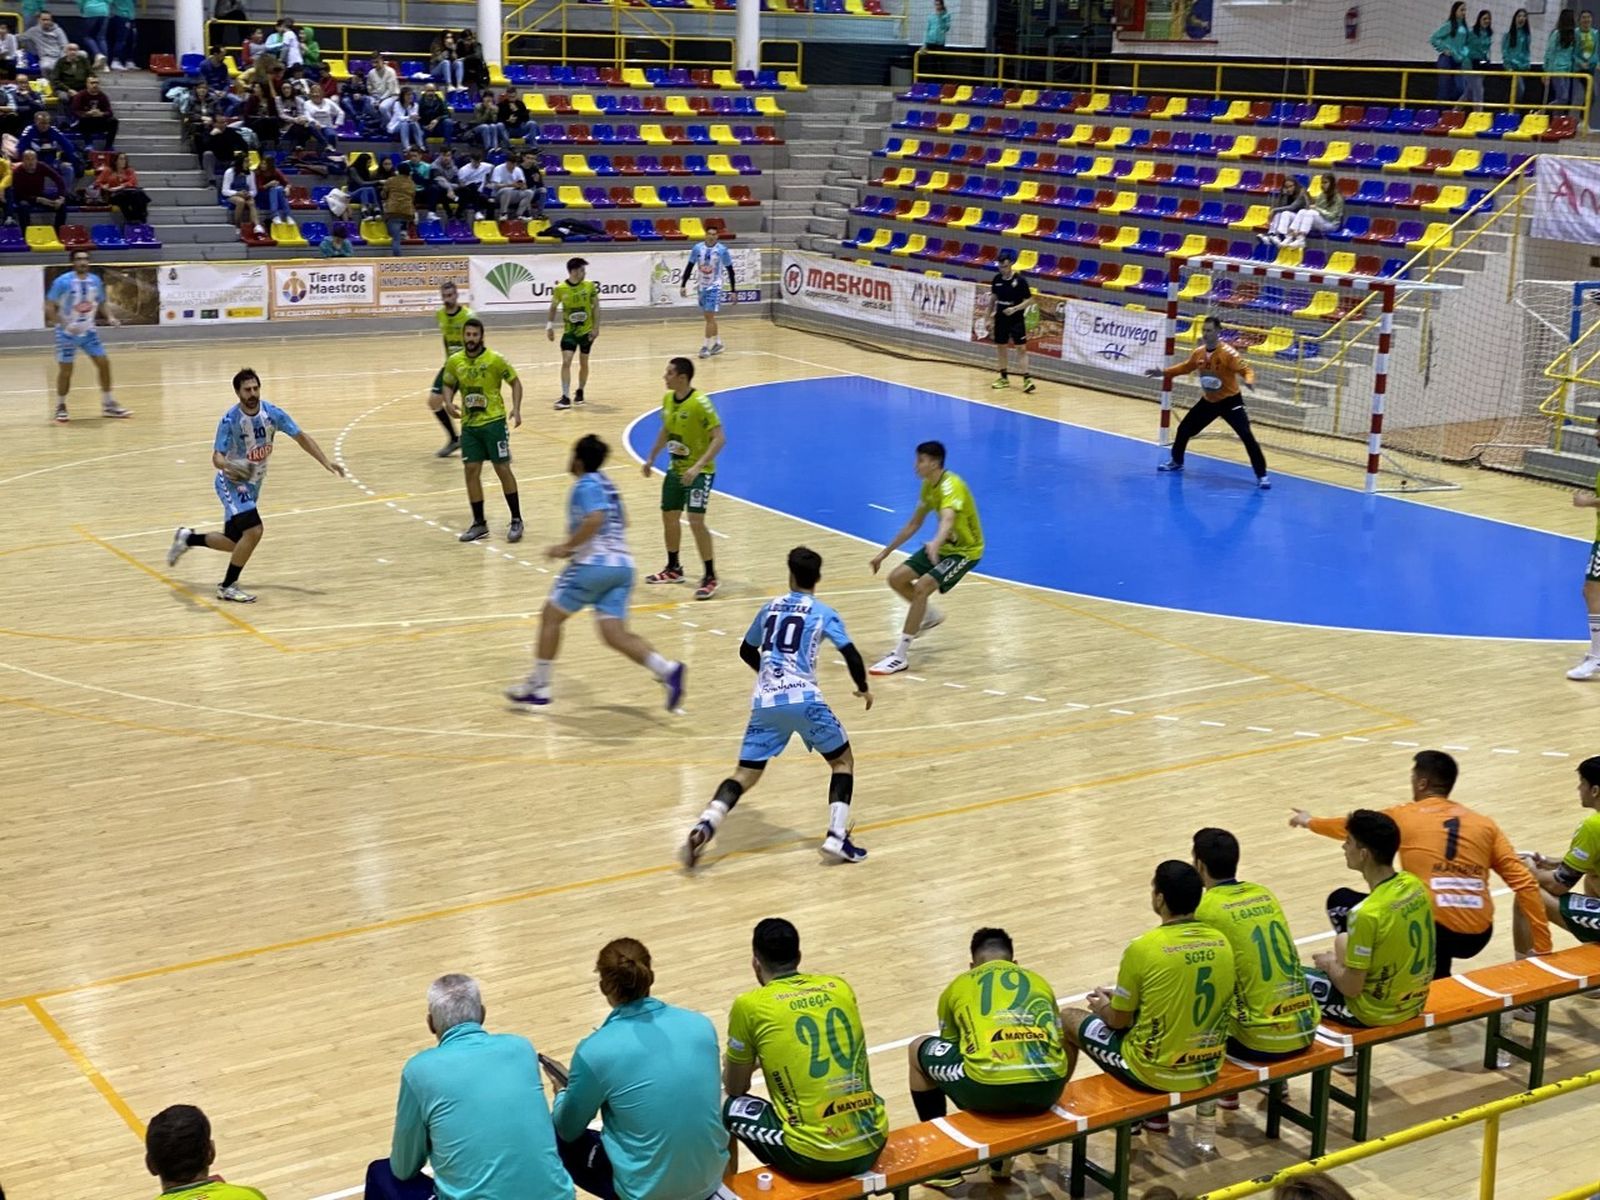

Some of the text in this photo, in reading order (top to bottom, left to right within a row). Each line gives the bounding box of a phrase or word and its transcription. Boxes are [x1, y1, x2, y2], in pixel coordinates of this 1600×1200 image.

[309, 270, 365, 282] Tierra de
[430, 261, 469, 271] DOCENTES
[309, 283, 366, 294] Maestros
[594, 281, 636, 295] Banco
[807, 268, 892, 301] MASKOM
[1093, 317, 1158, 346] Extruvega
[253, 427, 266, 439] 20
[761, 614, 805, 655] 10
[1443, 816, 1460, 861] 1
[1185, 949, 1215, 965] SOTO
[1251, 920, 1297, 982] 10
[1408, 909, 1435, 976] 21
[977, 970, 1031, 1016] 19
[1193, 966, 1216, 1027] 5
[795, 1007, 854, 1079] 20
[1005, 1031, 1045, 1041] MAYGAR
